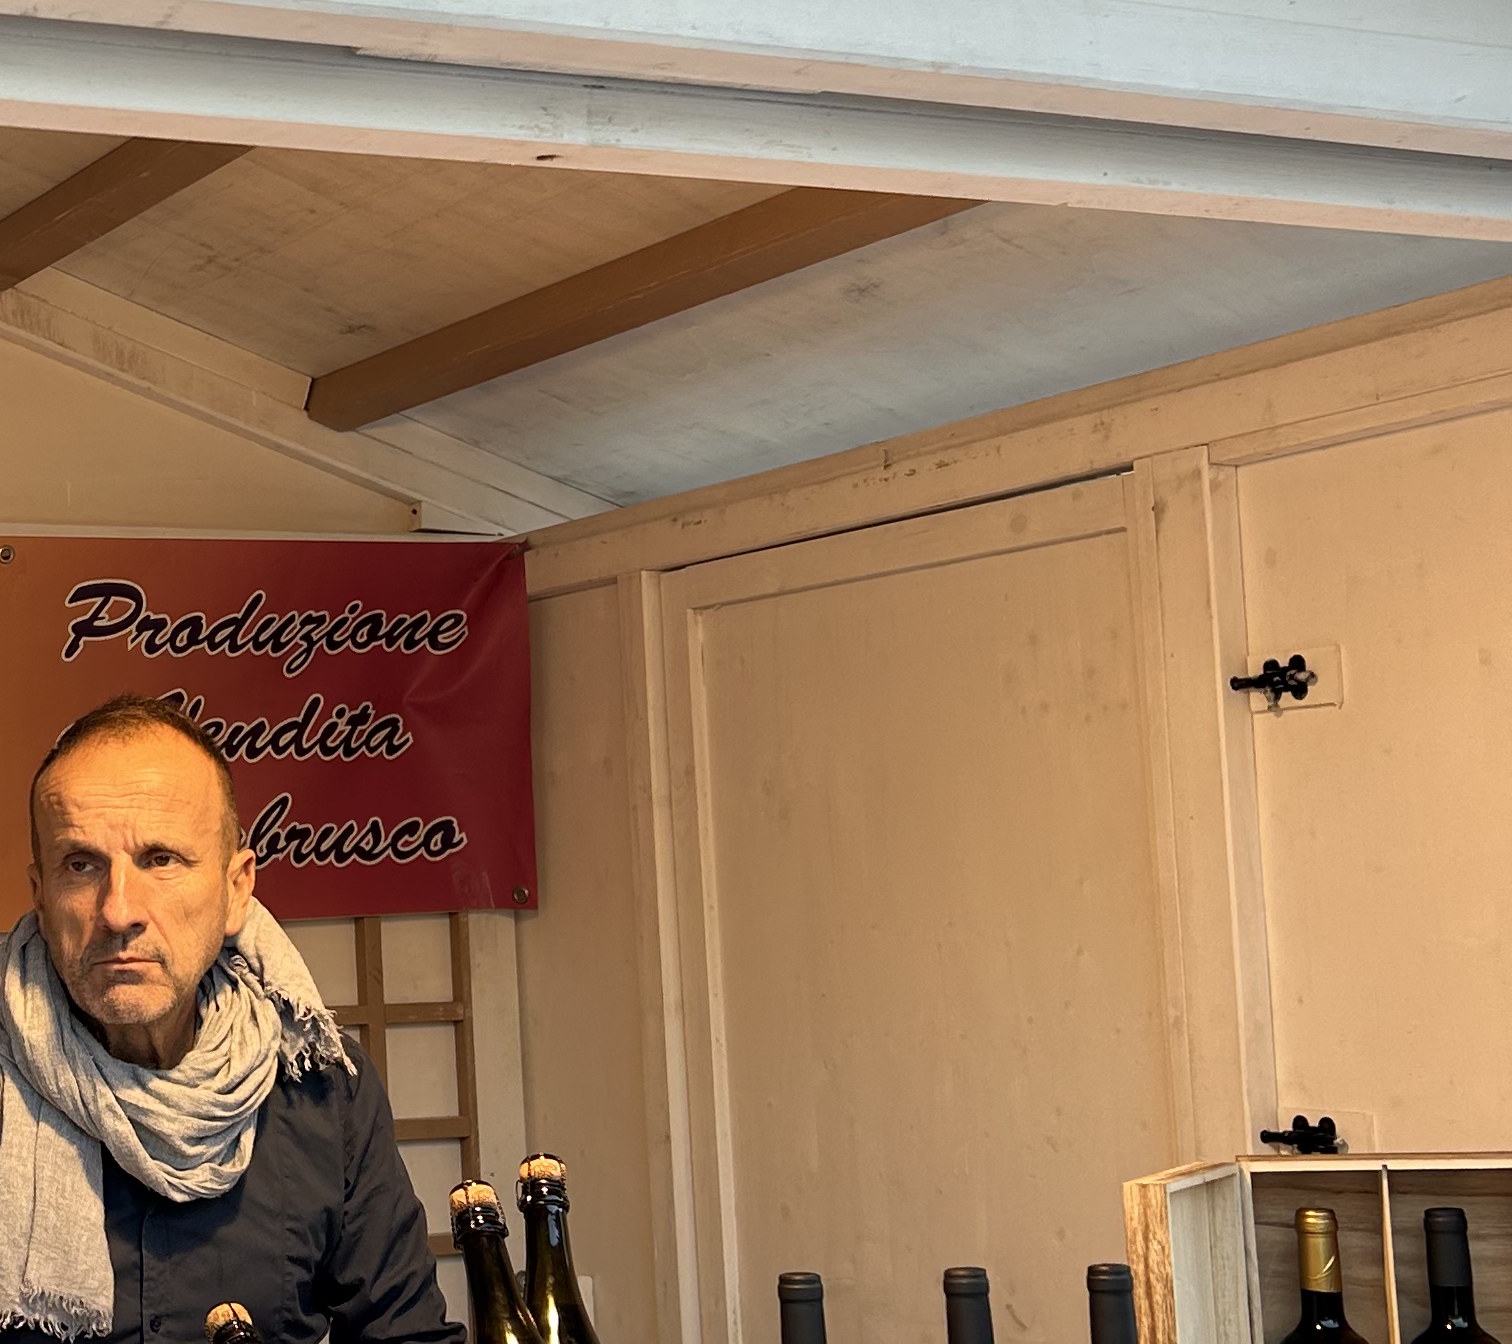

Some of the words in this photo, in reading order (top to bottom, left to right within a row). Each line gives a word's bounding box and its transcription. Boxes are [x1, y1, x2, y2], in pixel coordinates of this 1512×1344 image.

[62, 578, 468, 678] Produzione
[57, 689, 413, 762] endita
[240, 792, 468, 868] brusco
